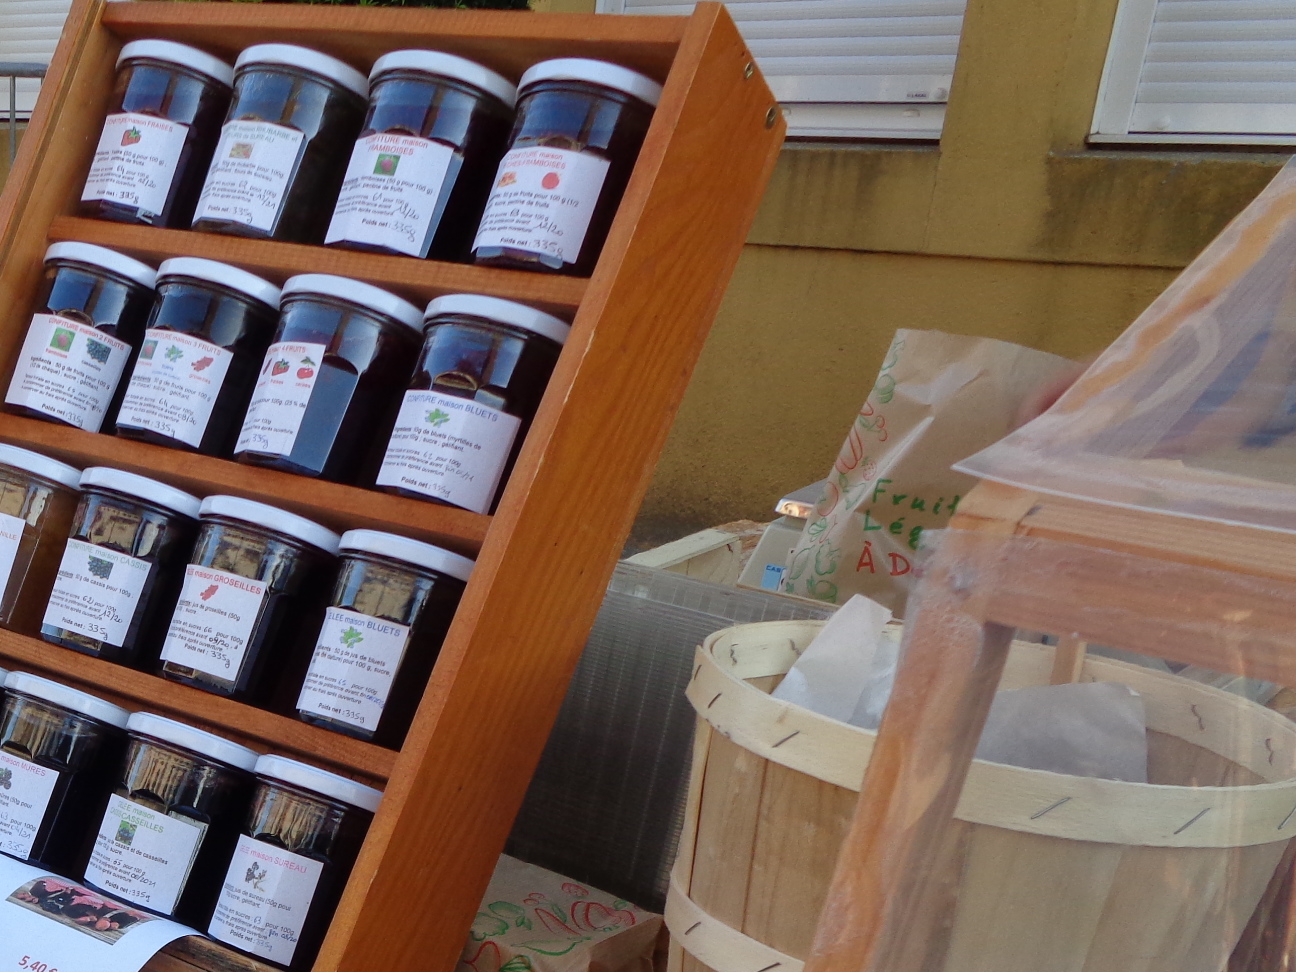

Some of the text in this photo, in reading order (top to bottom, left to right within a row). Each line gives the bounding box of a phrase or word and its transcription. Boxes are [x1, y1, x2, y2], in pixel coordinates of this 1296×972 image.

[437, 400, 464, 411] maison
[465, 404, 498, 422] BLUETS
[419, 480, 428, 489] net
[873, 478, 962, 515] Fruit
[863, 509, 924, 550] Lég
[95, 548, 119, 562] maison
[120, 555, 148, 572] CASSIS
[194, 571, 262, 595] maison GROSEILLES
[344, 617, 401, 637] maison BLUETS
[273, 856, 307, 874] SUREAU
[120, 886, 128, 894] net
